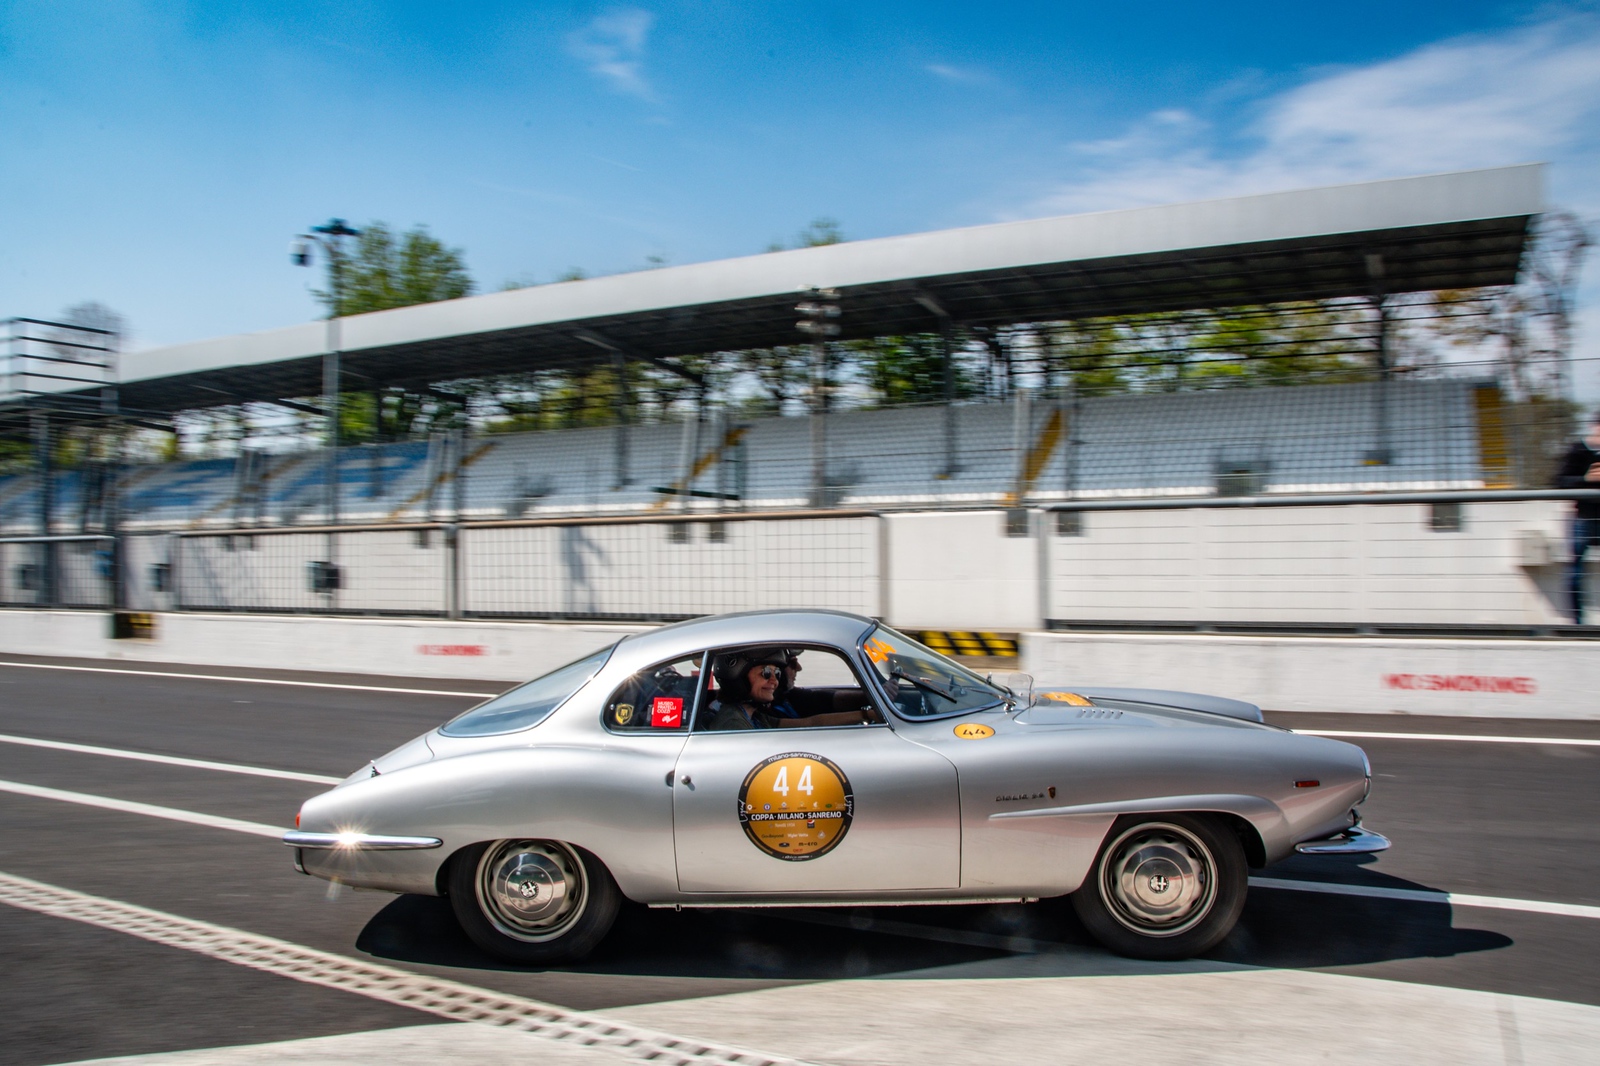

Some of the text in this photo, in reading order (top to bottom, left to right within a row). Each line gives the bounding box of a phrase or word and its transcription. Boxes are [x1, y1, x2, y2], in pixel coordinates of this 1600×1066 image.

[751, 811, 842, 821] COPPA MILANO SANREMO
